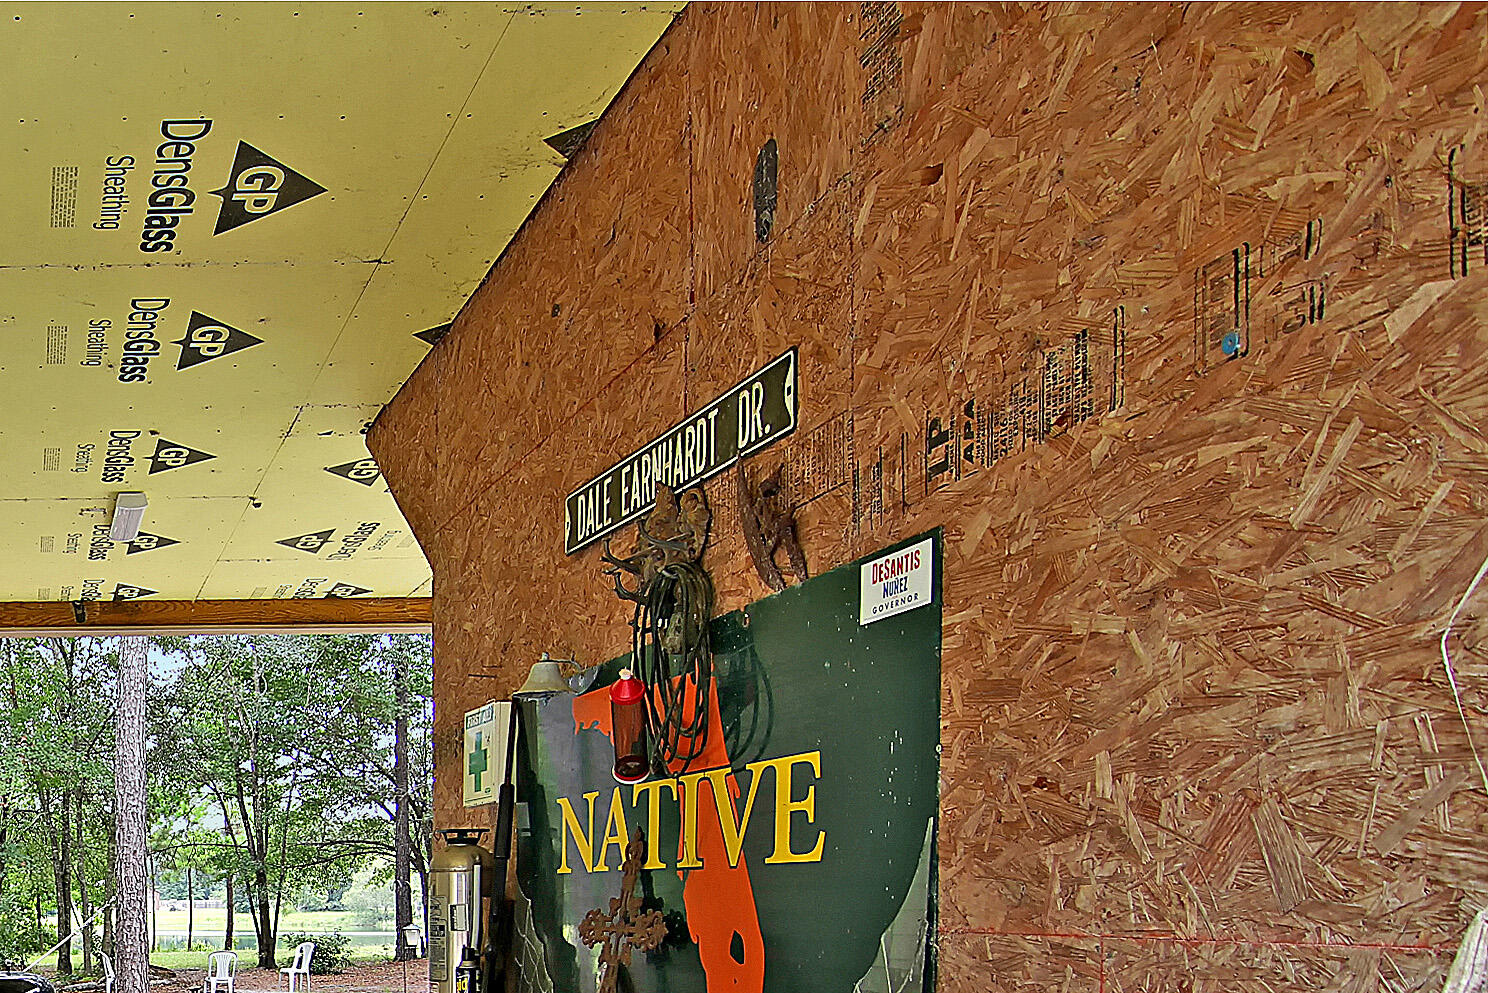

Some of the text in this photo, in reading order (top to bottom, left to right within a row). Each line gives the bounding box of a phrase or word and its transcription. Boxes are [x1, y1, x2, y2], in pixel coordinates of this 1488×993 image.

[93, 155, 135, 230] Sheathing
[138, 118, 214, 255] DensGlass
[231, 165, 286, 214] GP
[80, 318, 112, 367] Sheathing
[117, 297, 170, 384] DensGlass
[188, 325, 231, 357] GP
[100, 430, 142, 484] DensGlass
[156, 446, 190, 467] GP
[347, 459, 380, 482] GP
[577, 476, 613, 542] DALE
[621, 408, 719, 517] EARNHARDT
[737, 381, 771, 449] DR.
[872, 593, 919, 614] GOVERNOR
[556, 750, 827, 875] NATIVE
